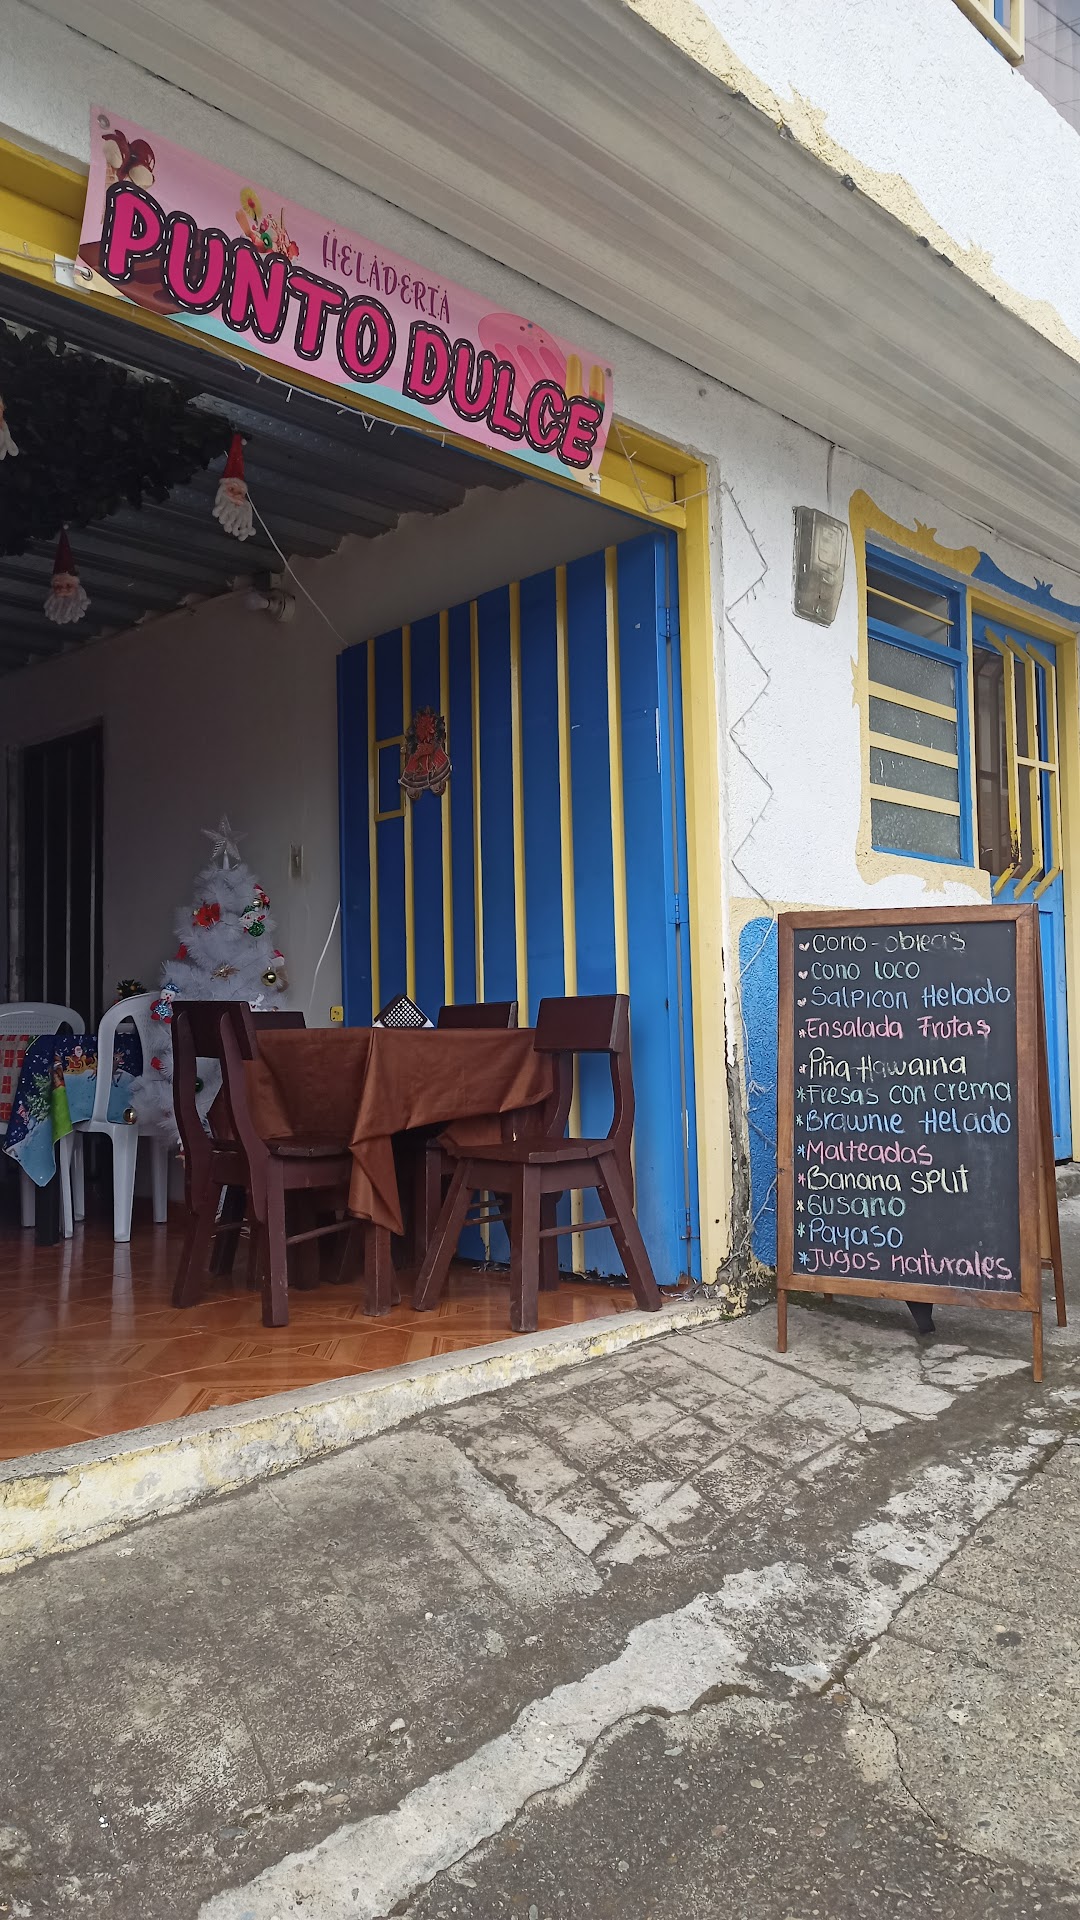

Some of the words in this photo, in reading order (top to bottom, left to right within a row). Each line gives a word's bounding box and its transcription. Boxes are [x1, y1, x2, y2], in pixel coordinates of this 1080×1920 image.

[102, 182, 396, 383] PUNTO
[403, 320, 604, 469] DULCE
[922, 978, 1011, 1008] Helado
[805, 1015, 903, 1039] Ensalada
[917, 1016, 991, 1039] Frutas
[809, 1047, 850, 1080] Piña
[806, 1084, 879, 1105] Fresas
[889, 1085, 926, 1104] con
[919, 1106, 1011, 1135] Helado
[806, 1140, 933, 1165] Malteadas
[807, 1165, 901, 1191] Banana
[808, 1194, 906, 1218] Gusano
[809, 1217, 903, 1250] Payaso
[807, 1248, 880, 1273] Jugos
[892, 1248, 1013, 1280] naturales
